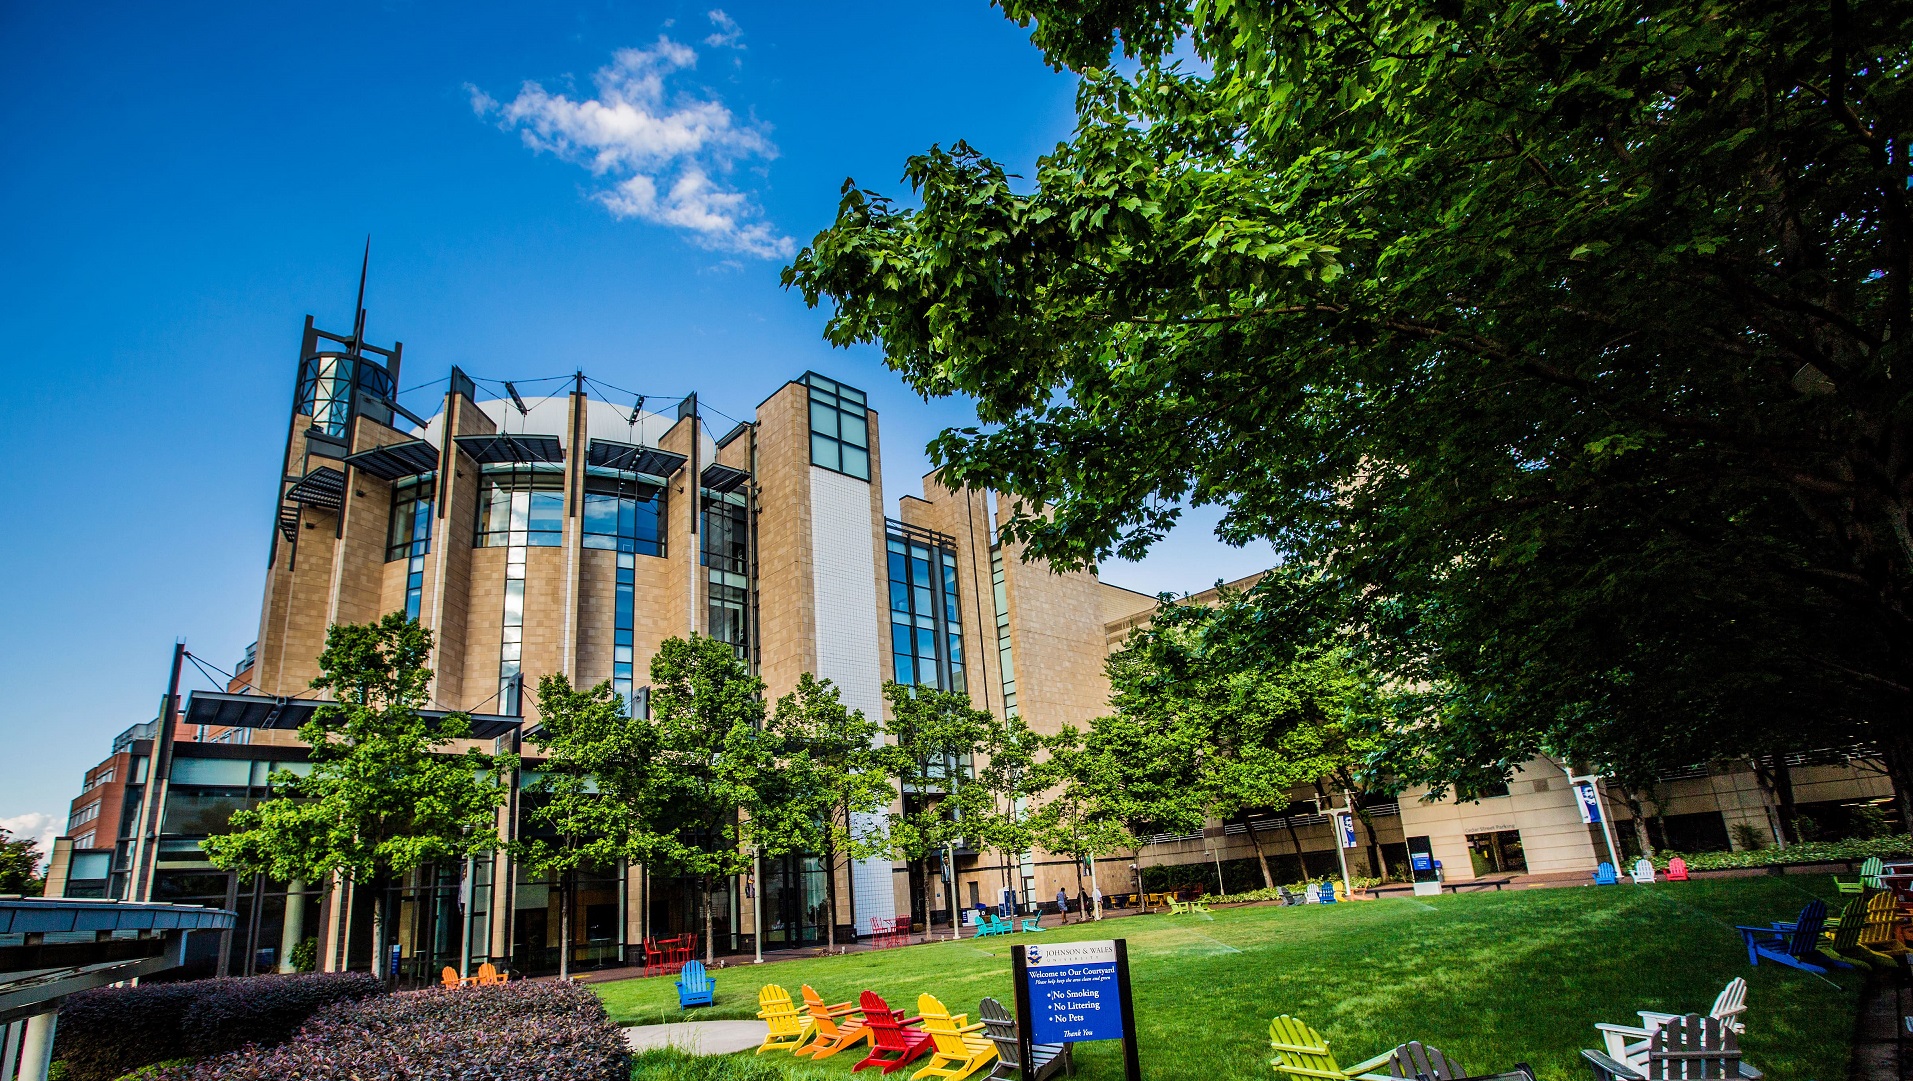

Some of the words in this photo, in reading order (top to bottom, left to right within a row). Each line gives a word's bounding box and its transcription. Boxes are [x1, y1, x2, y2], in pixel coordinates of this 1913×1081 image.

[1083, 966, 1115, 976] Courtyard
[1053, 990, 1064, 998] No
[1067, 989, 1099, 998] Smoking
[1067, 1001, 1100, 1010] Littering
[1055, 1014, 1067, 1022] No
[1064, 1029, 1081, 1037] Thank
